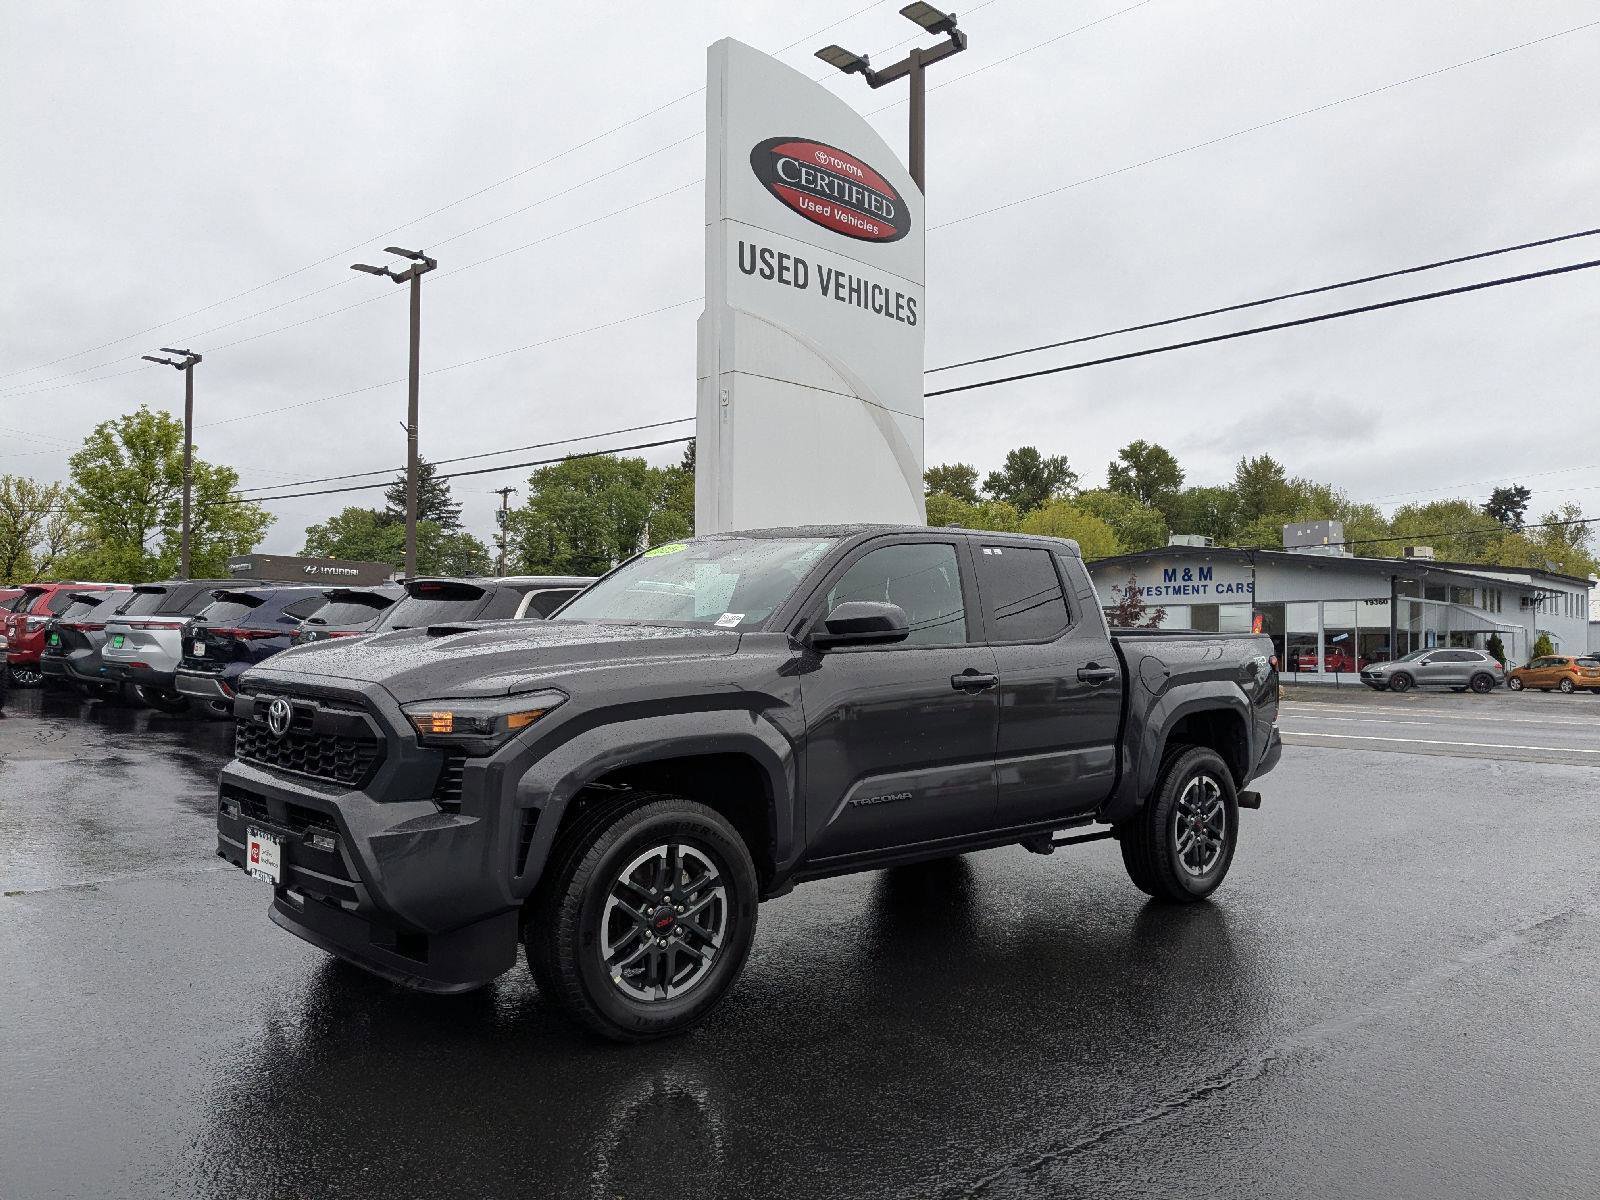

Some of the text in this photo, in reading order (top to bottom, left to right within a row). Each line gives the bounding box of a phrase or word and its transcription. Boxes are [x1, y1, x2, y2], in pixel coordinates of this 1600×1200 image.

[829, 156, 864, 178] TOYOTA
[776, 157, 895, 219] CERTIFIED
[799, 196, 879, 235] Used Vehicles
[738, 240, 917, 326] USED VEHICLES
[321, 567, 359, 576] HYUNDAI
[1163, 566, 1213, 582] M & M
[1123, 582, 1254, 597] IVESTMENT CARS
[849, 792, 913, 807] TACOMA
